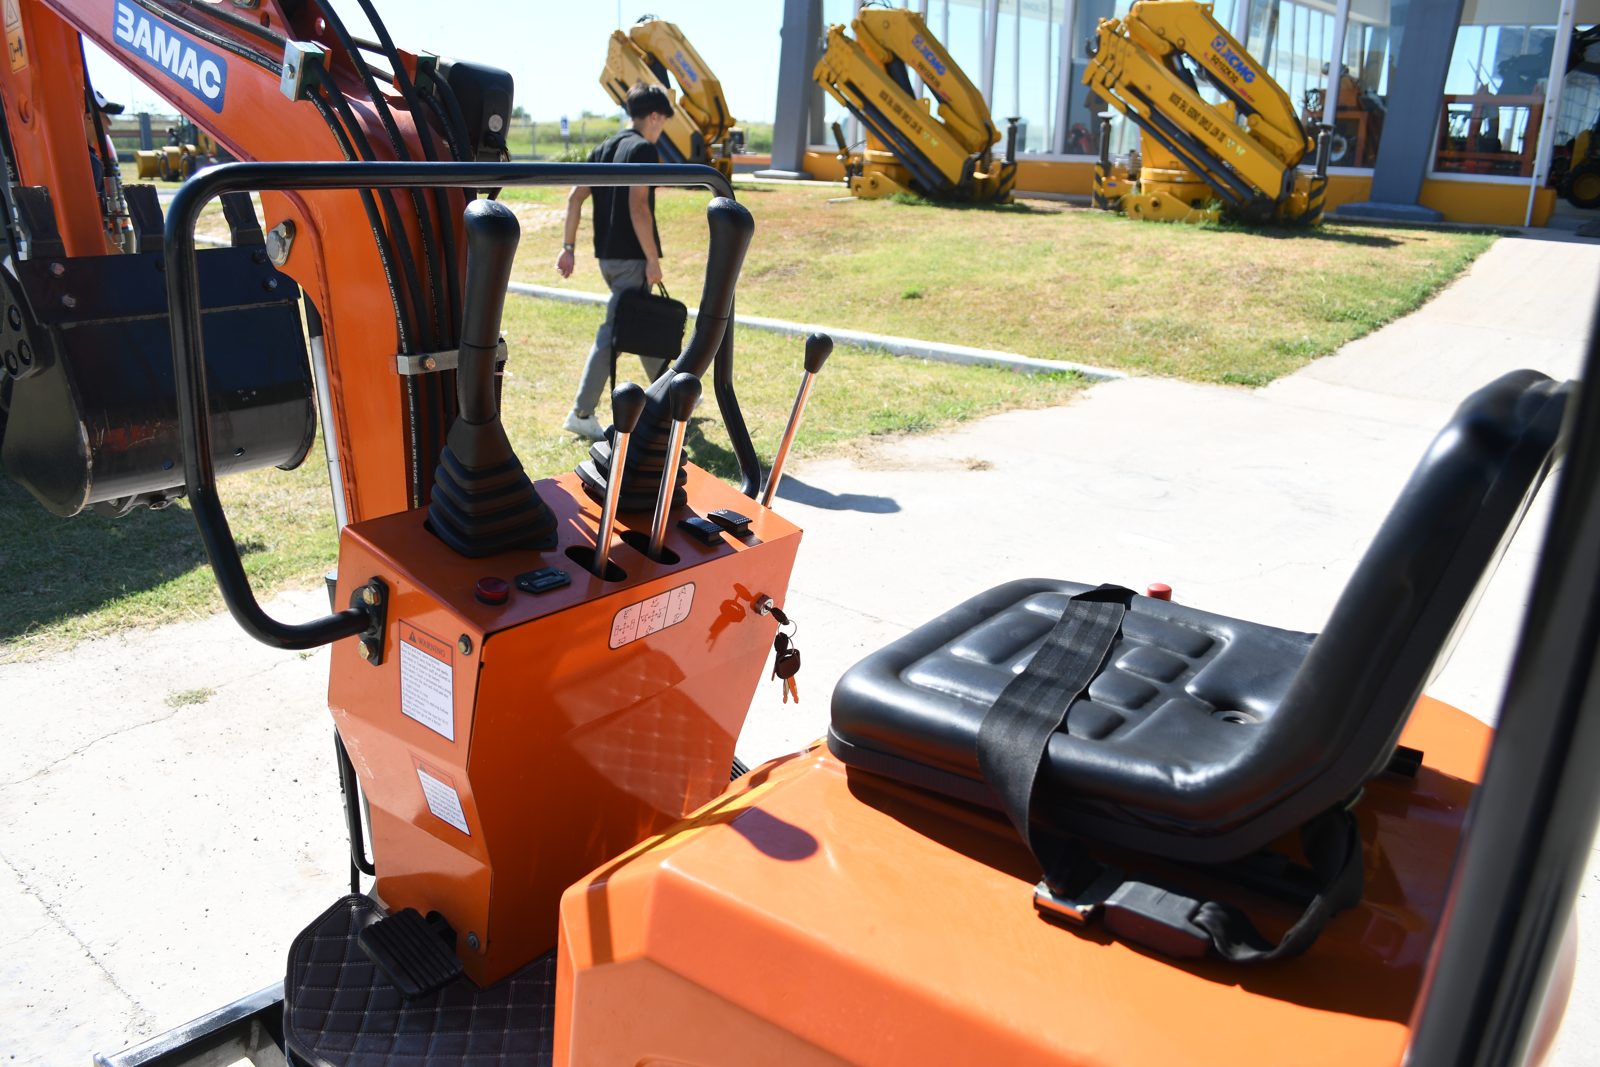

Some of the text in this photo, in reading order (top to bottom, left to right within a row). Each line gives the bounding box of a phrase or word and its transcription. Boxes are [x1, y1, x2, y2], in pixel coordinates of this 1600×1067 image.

[116, 2, 221, 98] BAMAC
[1222, 47, 1256, 84] XCMG
[390, 285, 401, 317] RESISTANT
[417, 636, 446, 657] WARNING
